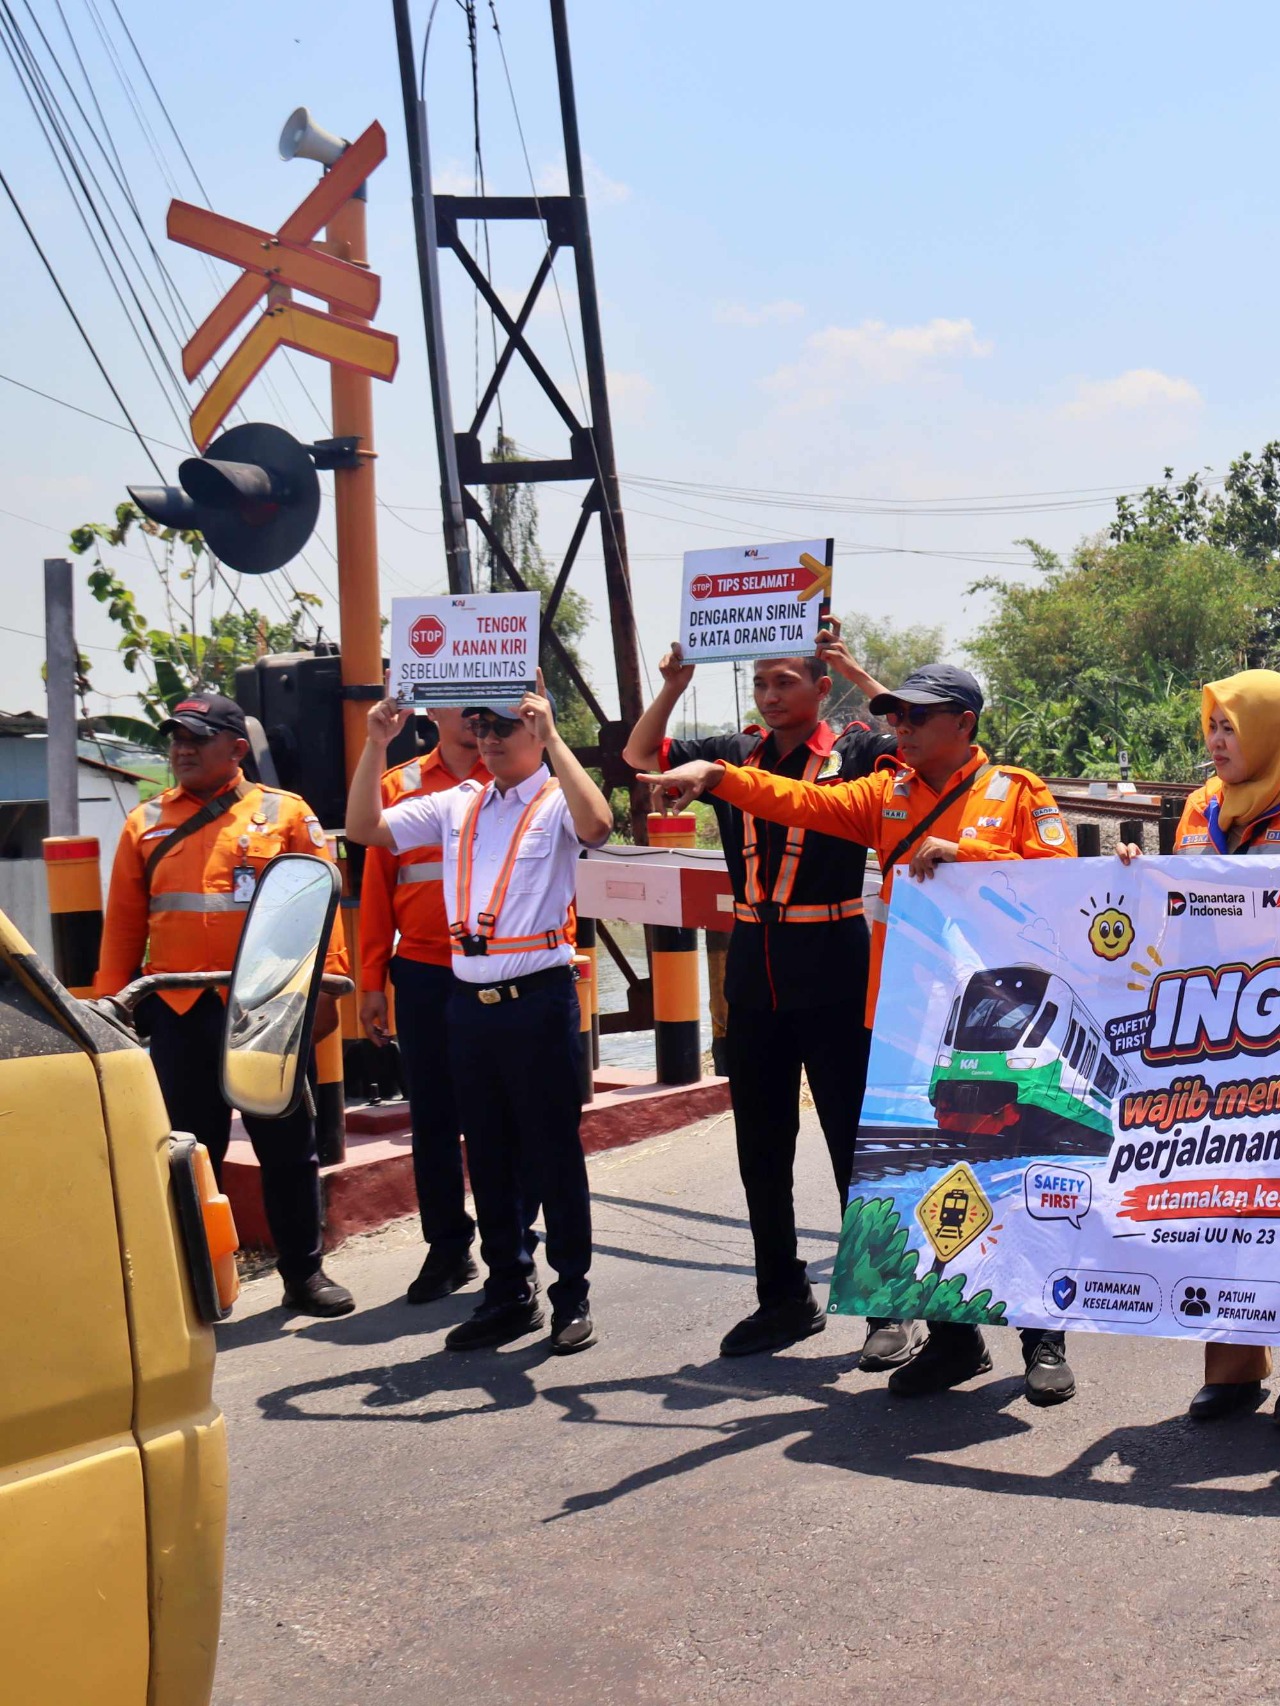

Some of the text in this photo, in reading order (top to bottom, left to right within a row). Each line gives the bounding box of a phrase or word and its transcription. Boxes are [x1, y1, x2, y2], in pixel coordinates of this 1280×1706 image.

[692, 573, 795, 592] STOP TIPS SELAMAT !
[690, 602, 807, 627] DENGARKAN SIRINE
[476, 616, 527, 633] TENGOK
[412, 630, 442, 643] STOP
[689, 624, 804, 648] & KATA ORANG TUA
[452, 638, 527, 656] KANAN KIRI
[401, 661, 526, 680] SEBELUM MELINTAS
[1189, 892, 1245, 904] Danantara
[1190, 904, 1243, 917] Indonesia
[1109, 1015, 1151, 1037] SAFETY
[1115, 1032, 1147, 1051] FIRST
[1122, 1077, 1209, 1129] wajib
[1034, 1174, 1085, 1193] SAFETY
[1040, 1193, 1079, 1209] FIRST
[1146, 1185, 1248, 1212] utamakan
[1151, 1227, 1200, 1244] Sesuai
[1204, 1227, 1228, 1244] UU
[1232, 1228, 1252, 1245] No
[1256, 1229, 1275, 1245] 23
[1084, 1281, 1141, 1295] UTAMAKAN
[1218, 1290, 1256, 1304] PATUHI
[1082, 1297, 1154, 1313] KESELAMATAN
[1217, 1307, 1276, 1322] PERATURAN
